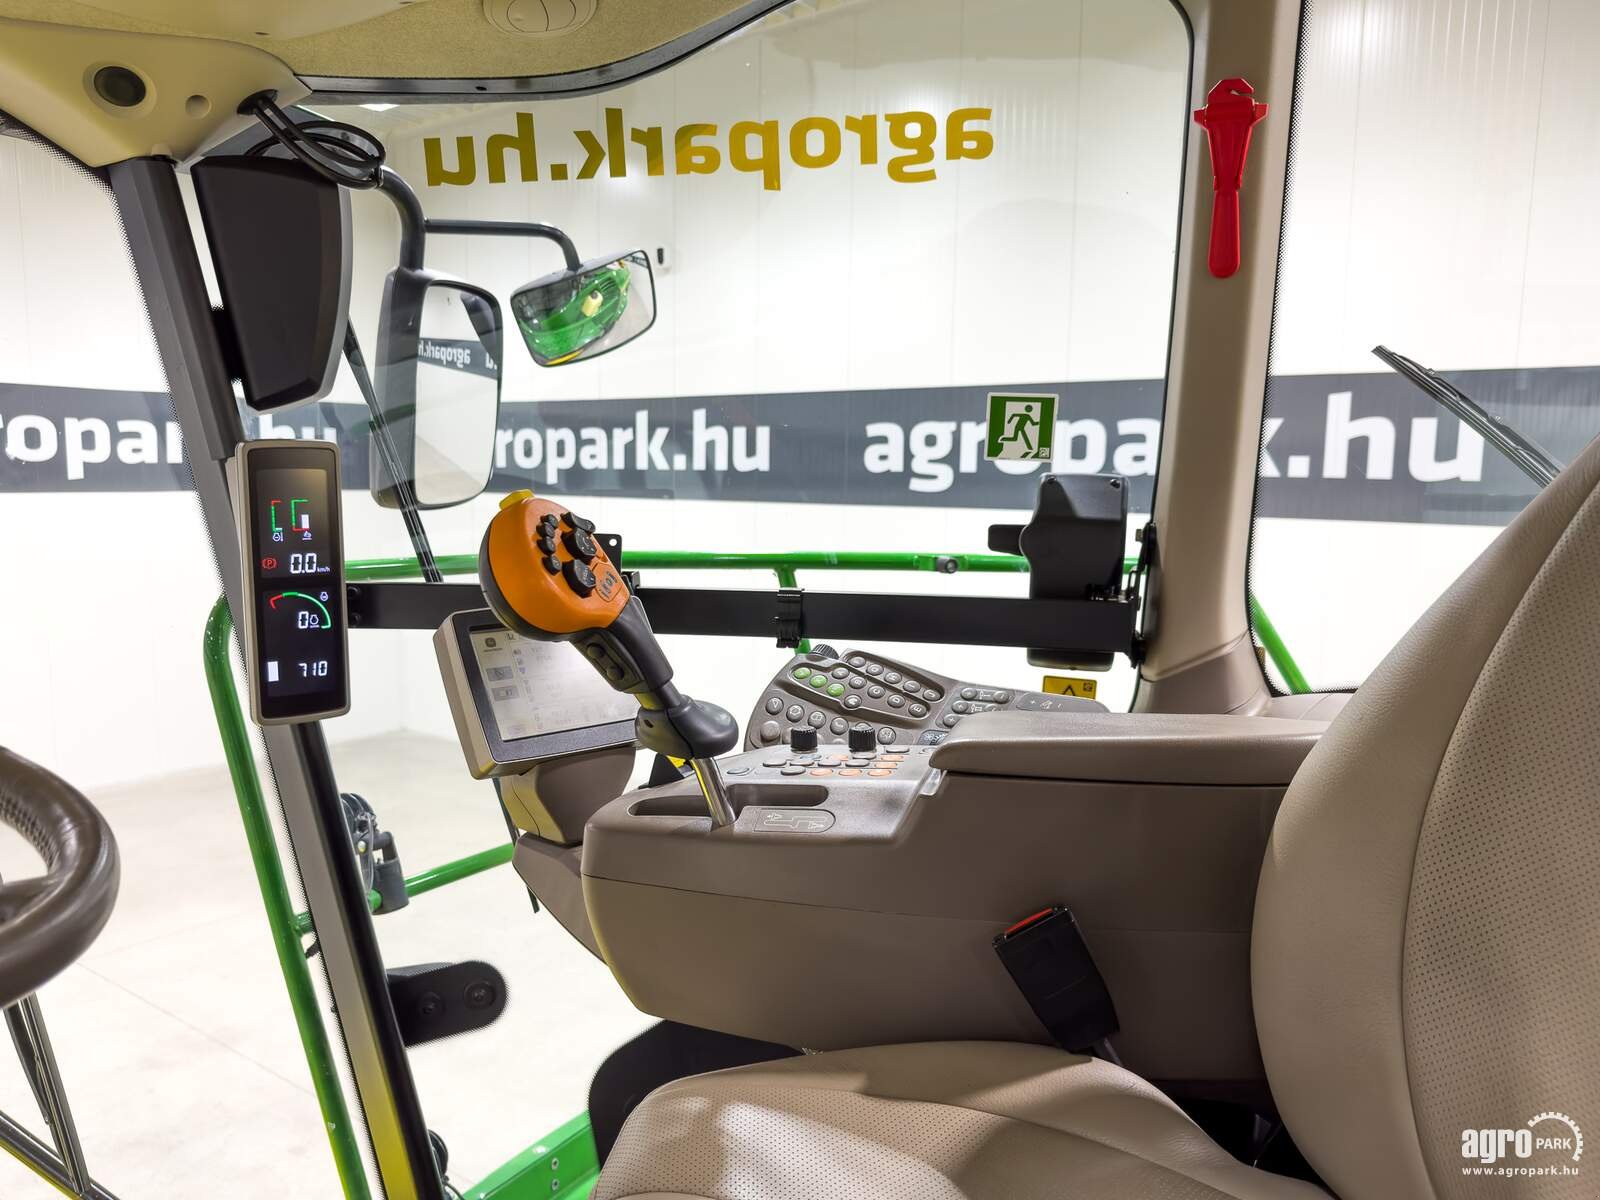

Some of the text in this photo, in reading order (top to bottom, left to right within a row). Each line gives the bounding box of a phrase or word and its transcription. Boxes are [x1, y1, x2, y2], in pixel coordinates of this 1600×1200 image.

[495, 408, 771, 485] ropark.hu
[290, 553, 317, 574] 0.0
[299, 660, 328, 678] 710
